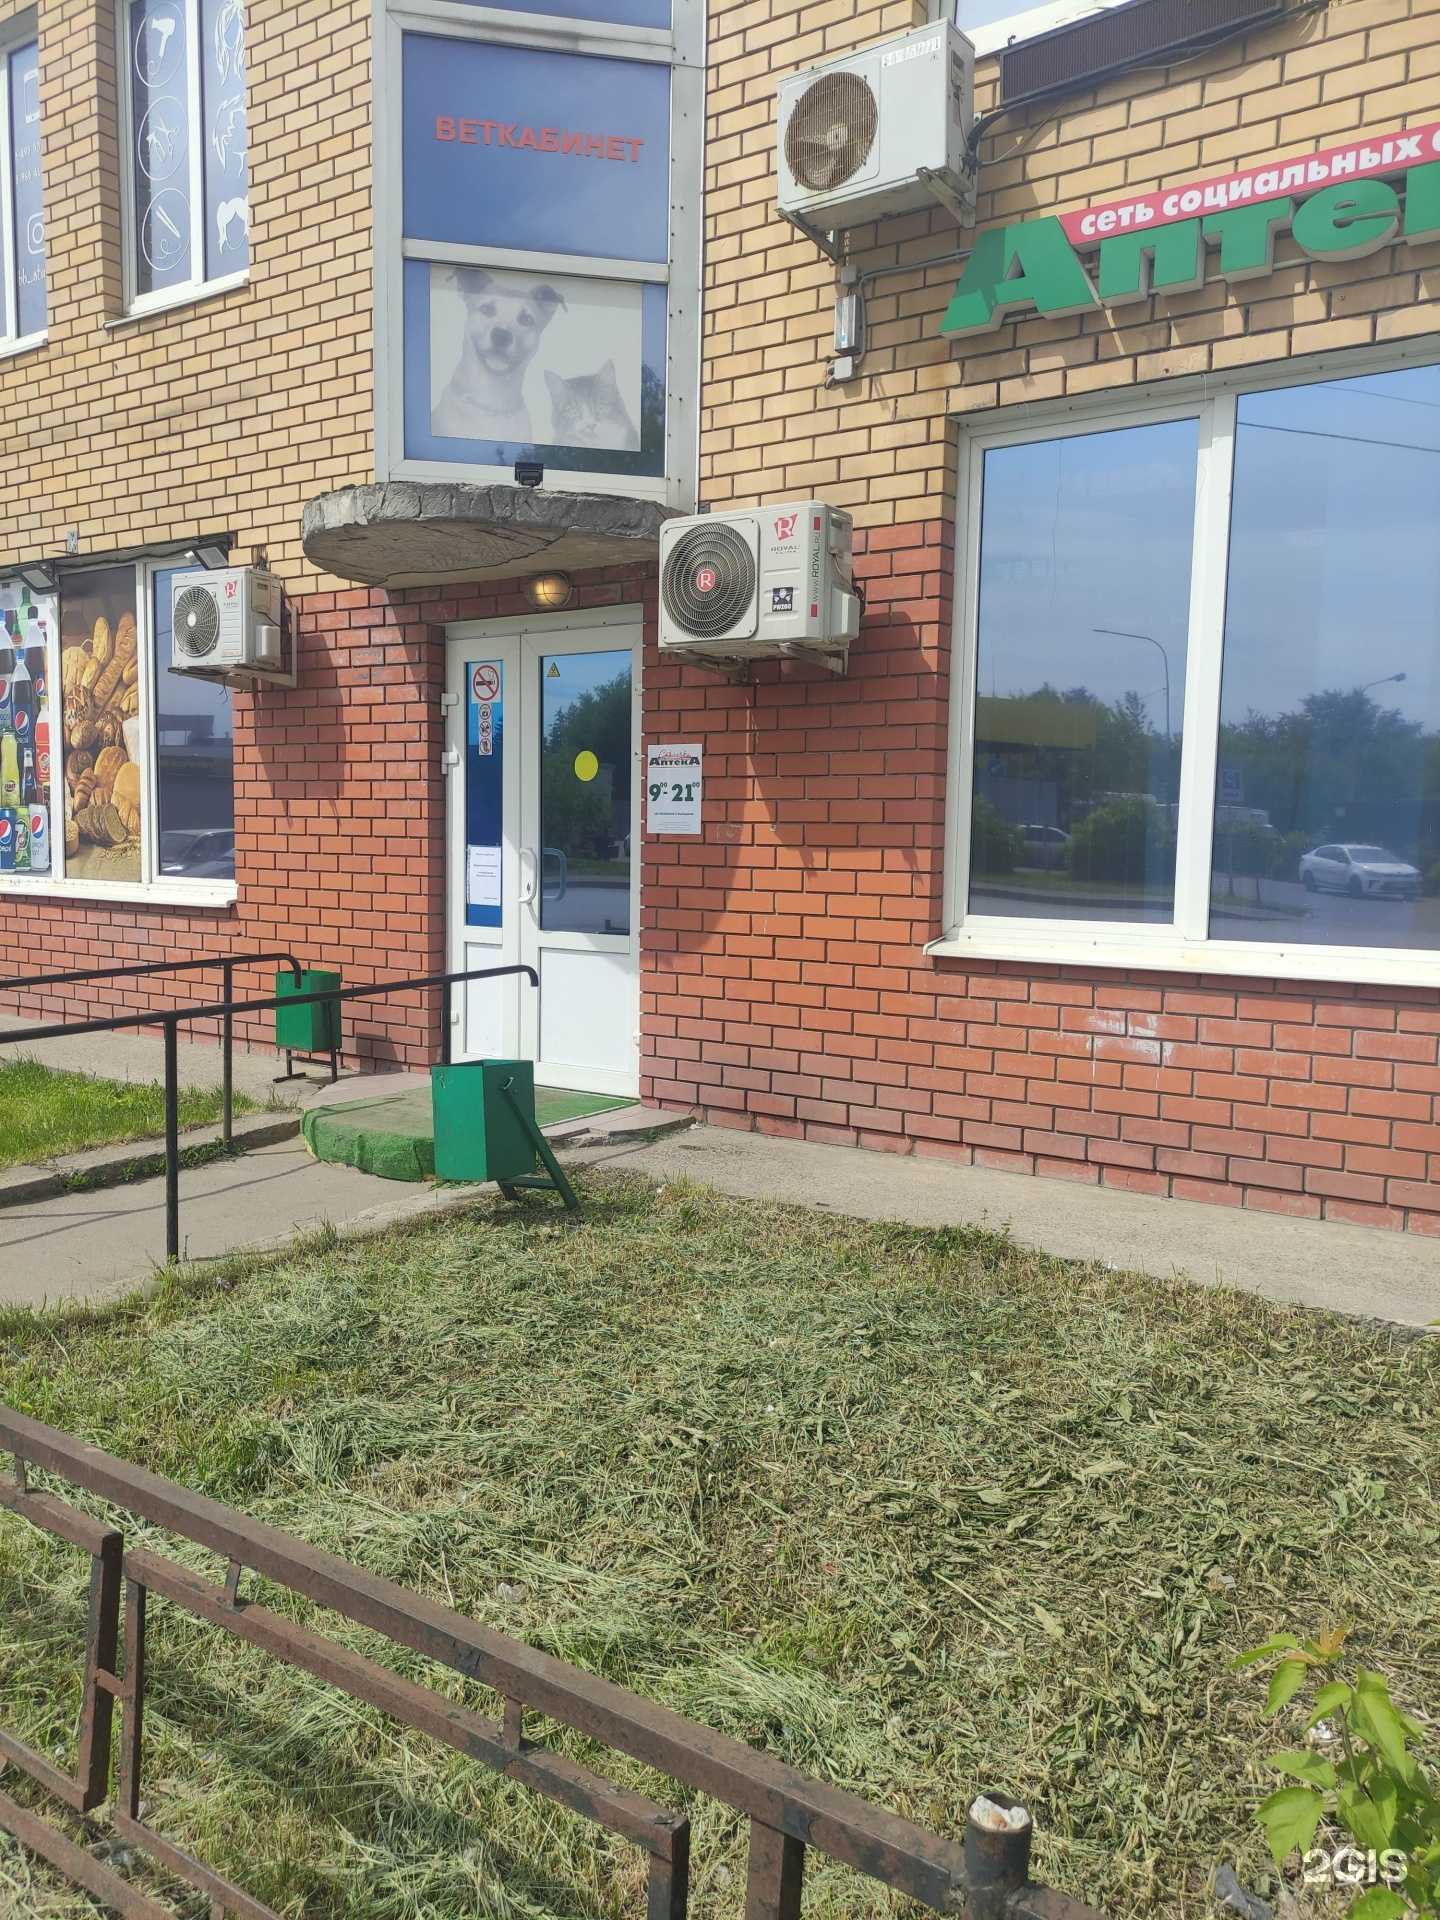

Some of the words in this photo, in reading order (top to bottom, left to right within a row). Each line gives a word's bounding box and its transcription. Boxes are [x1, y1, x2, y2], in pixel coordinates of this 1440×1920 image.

[435, 115, 646, 162] ВЕТКАБИНЕТ
[1081, 201, 1154, 236] сеть
[1162, 132, 1423, 215] социальных
